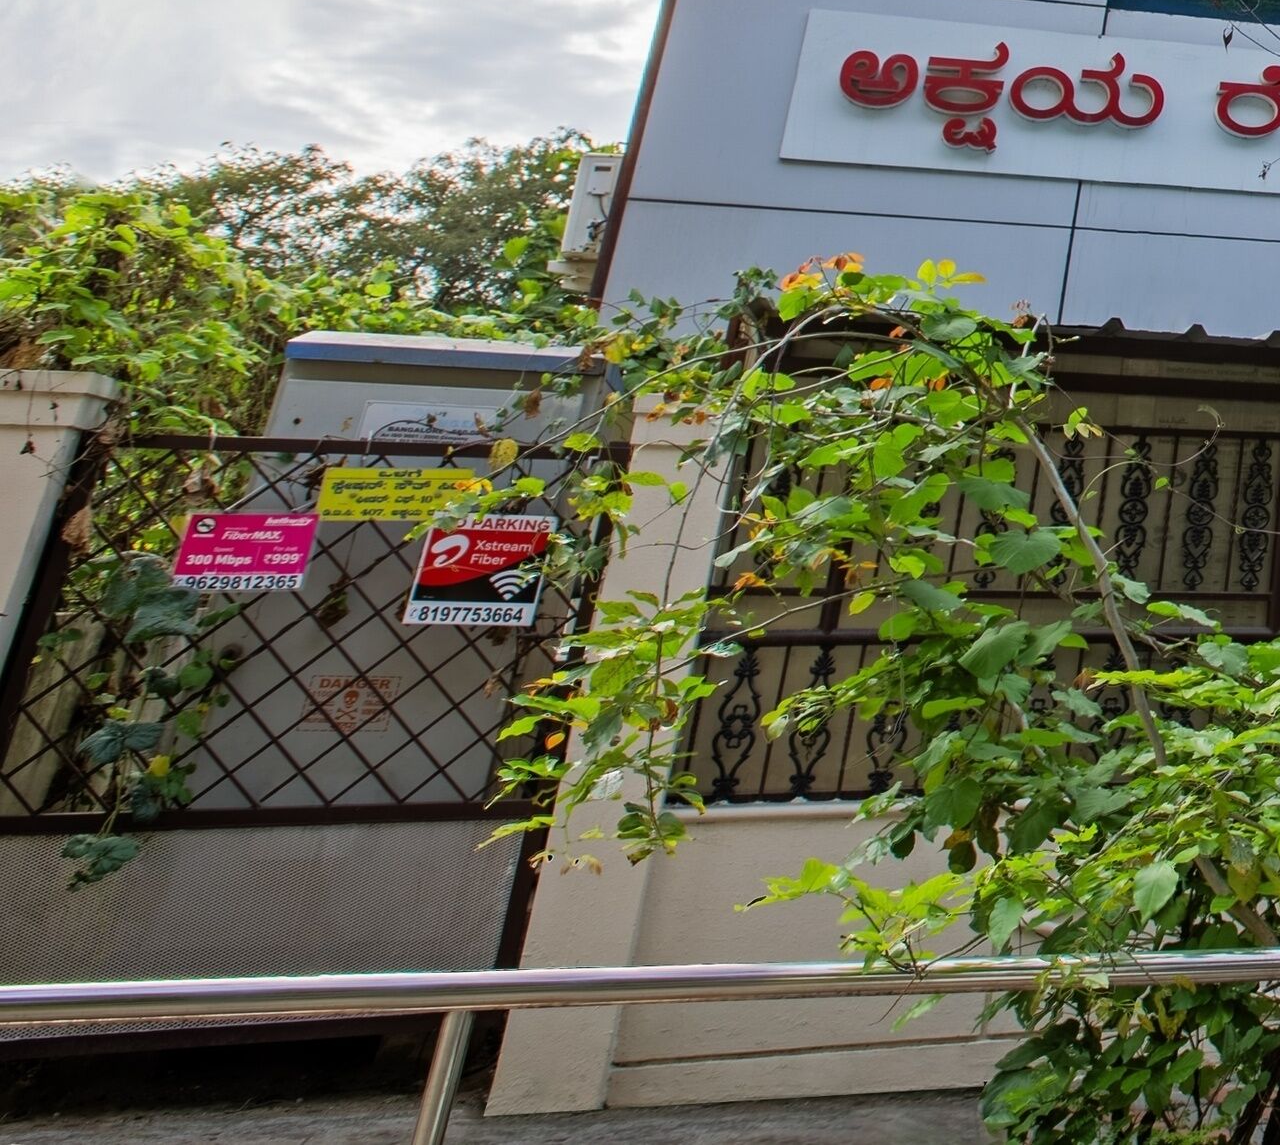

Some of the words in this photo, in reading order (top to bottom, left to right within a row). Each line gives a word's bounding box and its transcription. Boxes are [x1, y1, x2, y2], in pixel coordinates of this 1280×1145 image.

[839, 41, 1165, 154] ಅಕ್ಷಯ
[471, 518, 550, 532] PARKING
[474, 539, 532, 552] Xstream
[185, 554, 212, 565] 300
[214, 555, 253, 567] Mbps
[469, 553, 508, 565] Fiber
[184, 575, 298, 589] 9629812365
[418, 606, 524, 622] 8197753664
